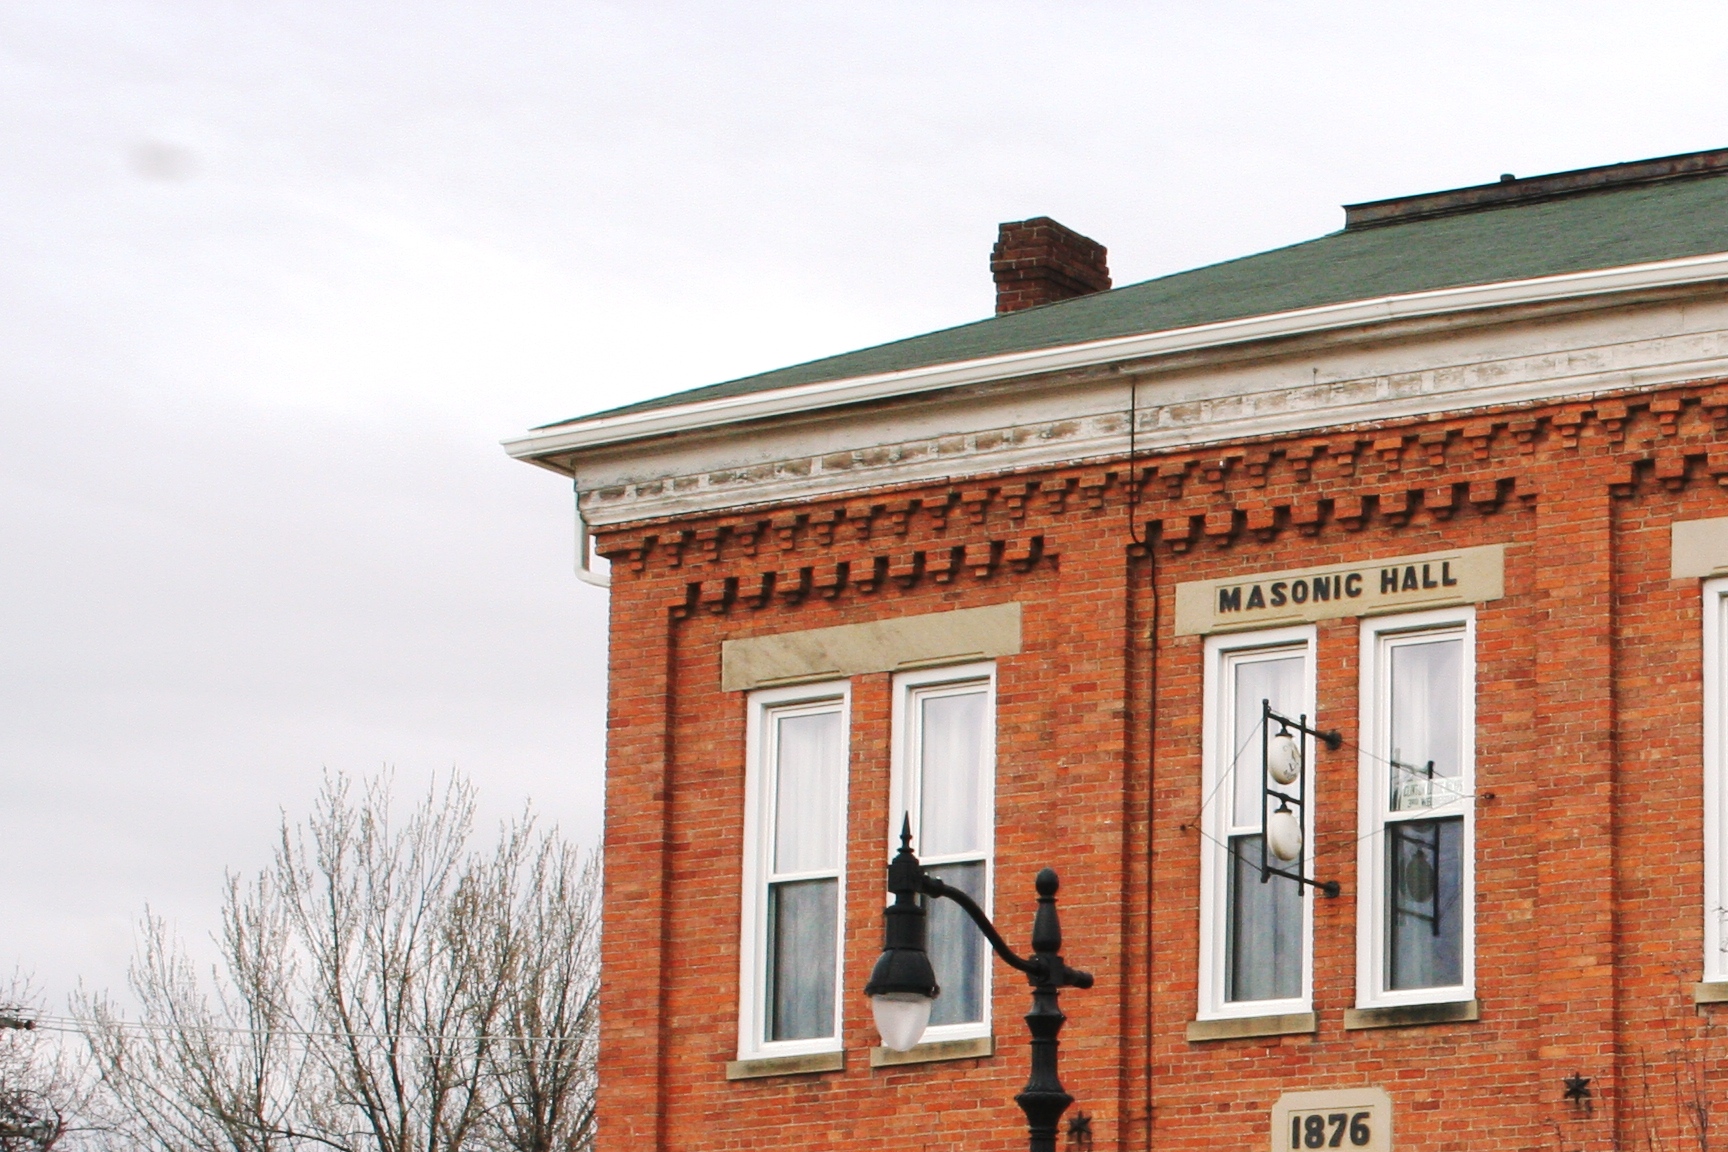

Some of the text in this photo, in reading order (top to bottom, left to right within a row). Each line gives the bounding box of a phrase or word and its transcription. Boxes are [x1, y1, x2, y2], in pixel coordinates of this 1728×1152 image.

[1218, 561, 1458, 613] MASONIC HALL
[1291, 1111, 1371, 1149] 1876
